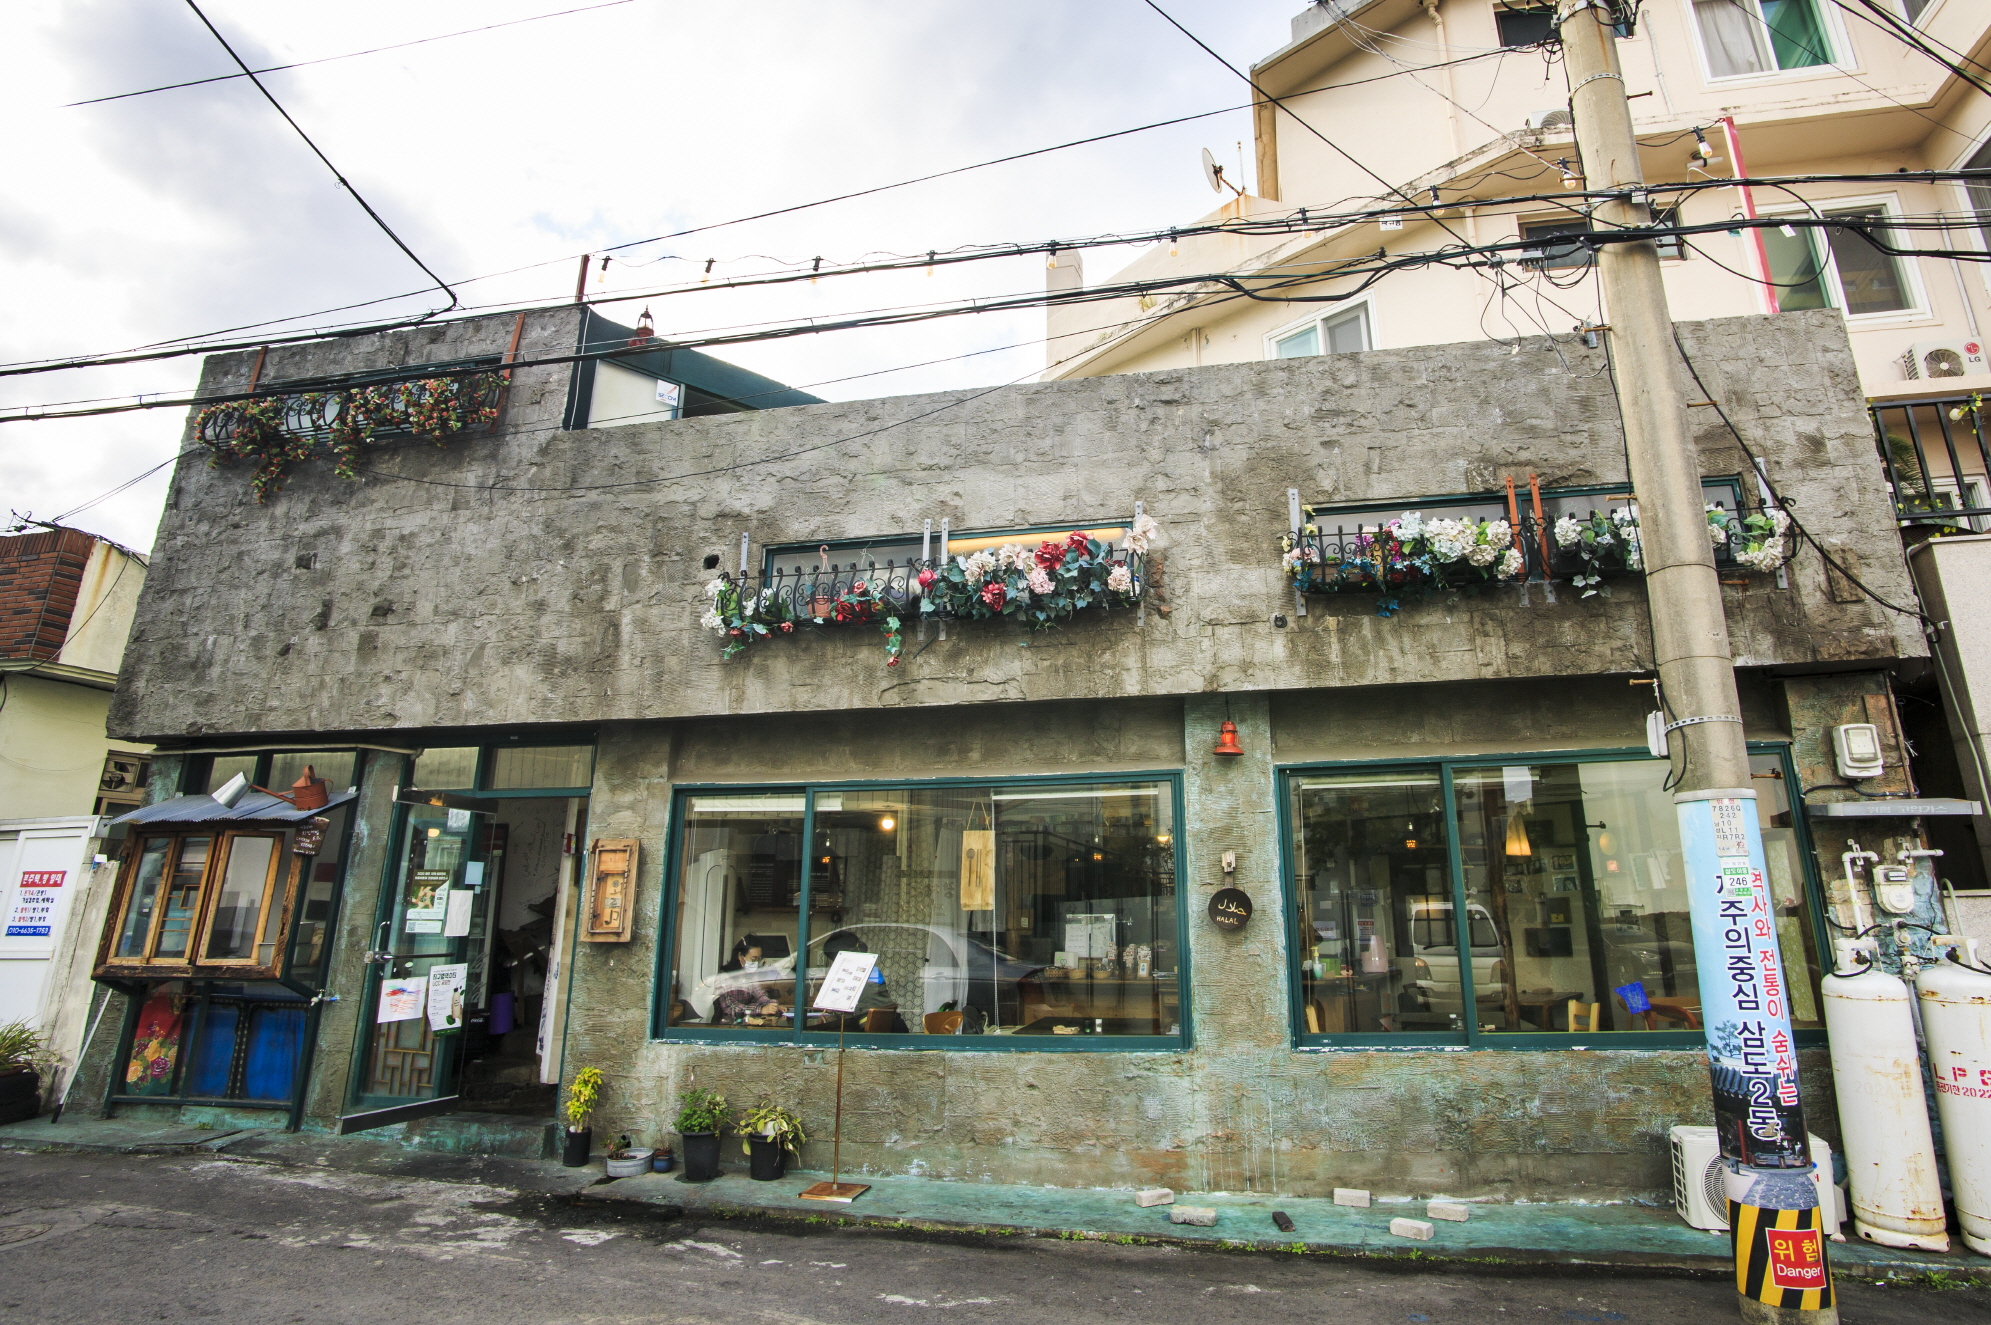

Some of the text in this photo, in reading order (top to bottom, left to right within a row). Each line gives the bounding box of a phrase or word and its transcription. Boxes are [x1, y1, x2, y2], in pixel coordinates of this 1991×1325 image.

[1867, 805, 1948, 814] 위험 고압가스
[1729, 877, 1748, 887] 246
[1217, 899, 1247, 915] حلال
[1217, 916, 1239, 925] HALAL
[1751, 870, 1797, 1105] 역사와 전통이 숨쉬는
[1737, 1020, 1779, 1140] 삼도2동
[1776, 1263, 1821, 1279] Danger
